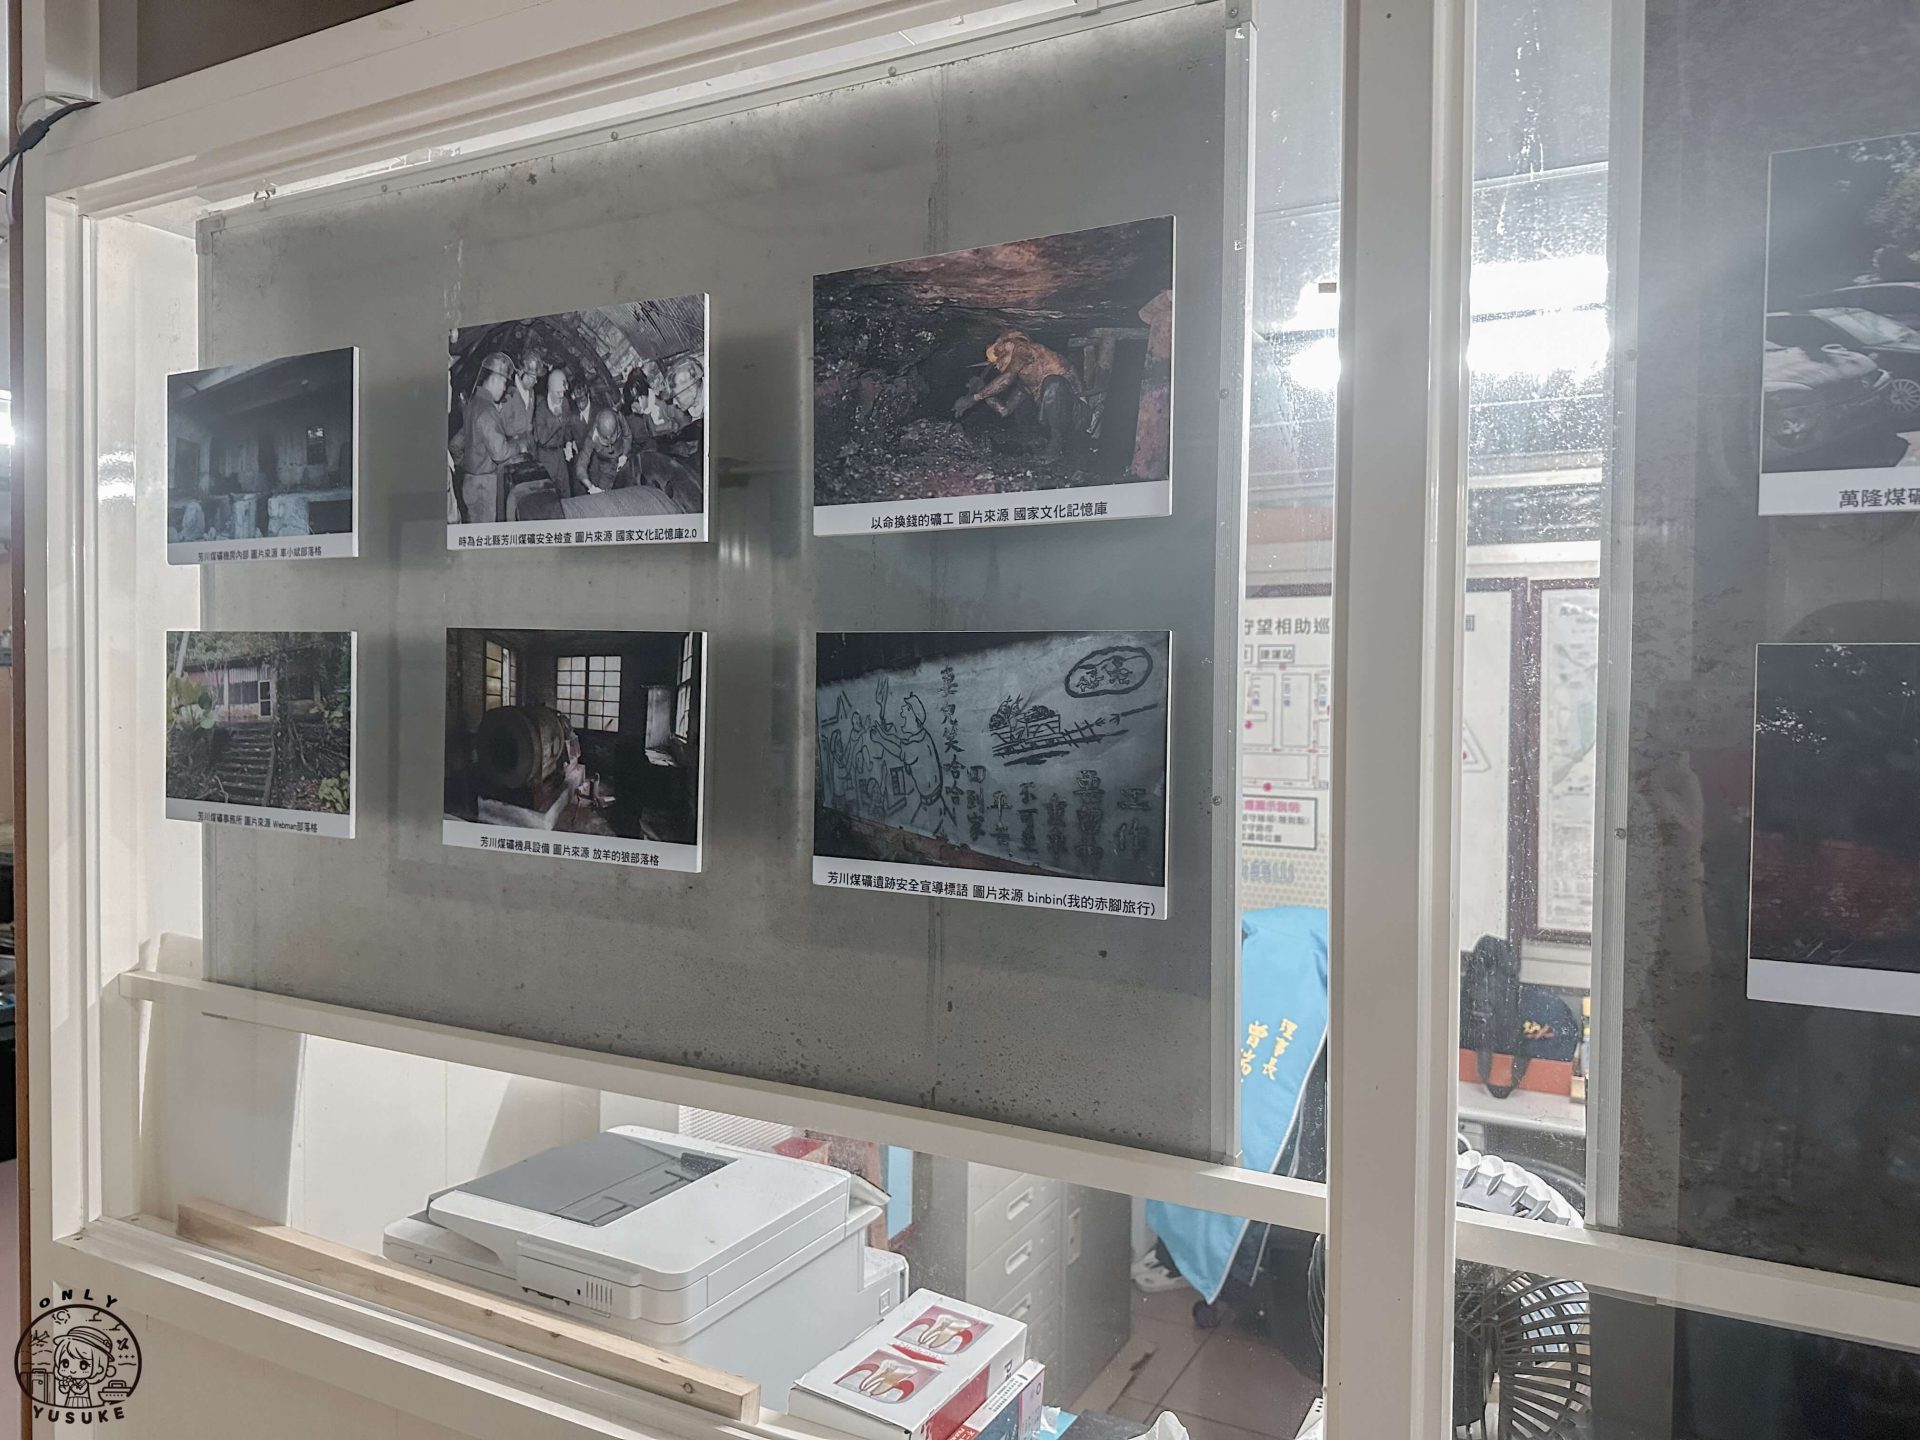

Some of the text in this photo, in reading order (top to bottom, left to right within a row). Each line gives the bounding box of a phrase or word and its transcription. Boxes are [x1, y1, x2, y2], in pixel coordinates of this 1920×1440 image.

[871, 501, 1108, 529] 以命換錢的礦工 圖片來源 國家文化記憶庫
[458, 528, 697, 547] 時為台北縣芳川煤礦安全檢查 圖片來源 國家文化記憶庫2.0
[251, 547, 278, 559] 圖片來源
[244, 816, 270, 828] 圖片來源
[480, 836, 659, 866] 芳川煤礦機具設備 圖片來源 放羊的狼部落格
[827, 871, 1156, 917] 芳川煤礦遺跡安全宣導標語 圖片來源 binbin(我的赤腳旅行)
